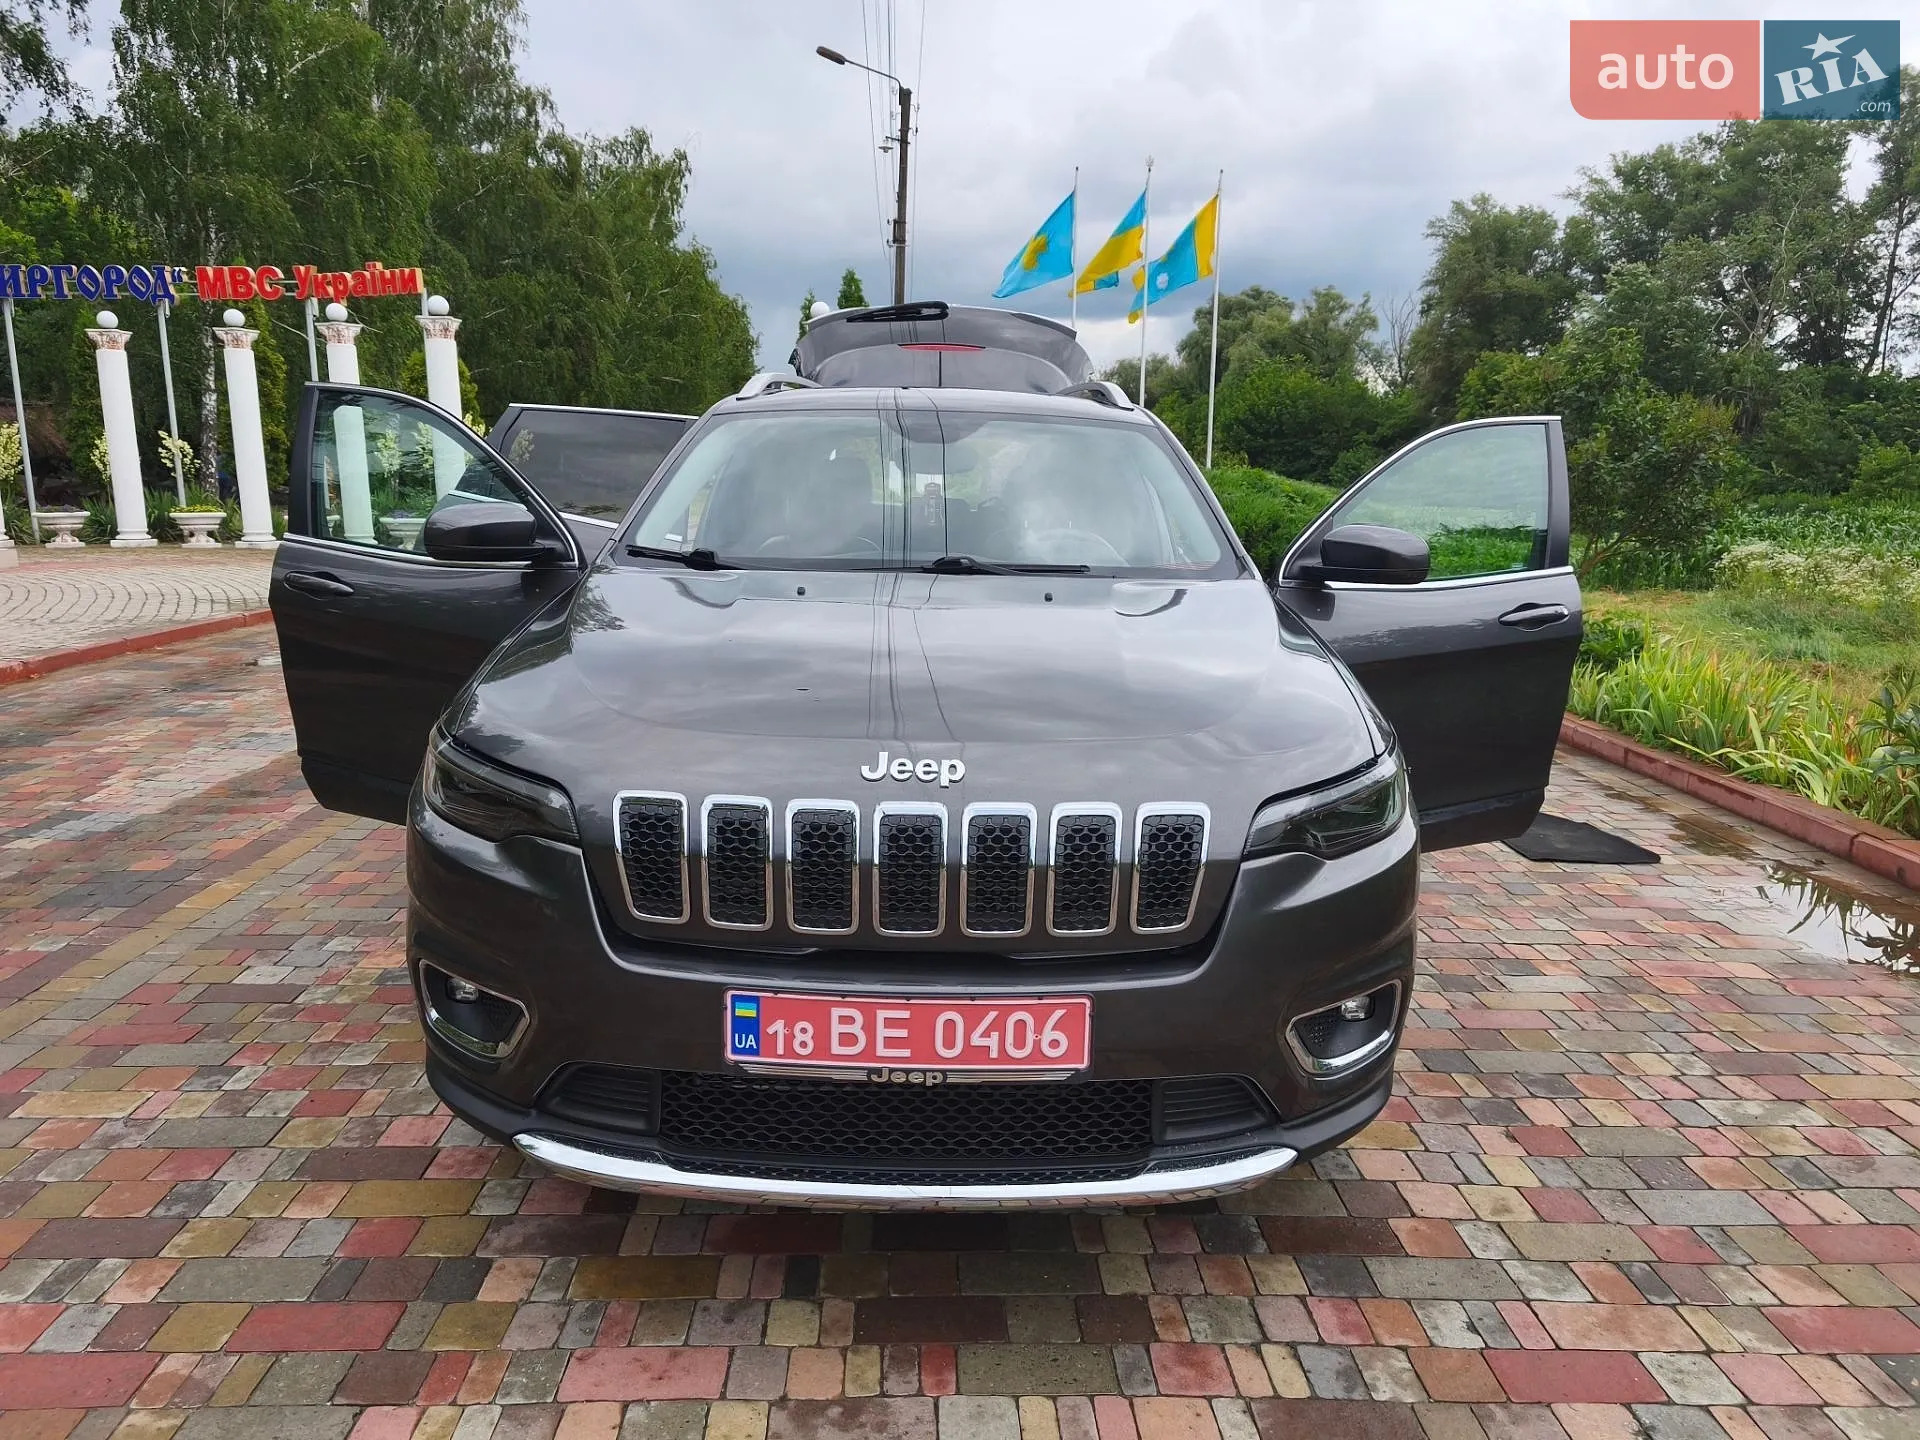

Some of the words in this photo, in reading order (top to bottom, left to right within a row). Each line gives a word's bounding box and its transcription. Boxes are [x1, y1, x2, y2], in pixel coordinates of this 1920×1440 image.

[196, 265, 283, 300] МВС
[293, 262, 423, 304] України
[860, 751, 966, 789] Jeep
[734, 1033, 758, 1050] UA
[766, 1019, 815, 1056] 18
[830, 1007, 911, 1058] BE
[934, 1009, 1069, 1059] 0406
[870, 1067, 944, 1086] Jeep
